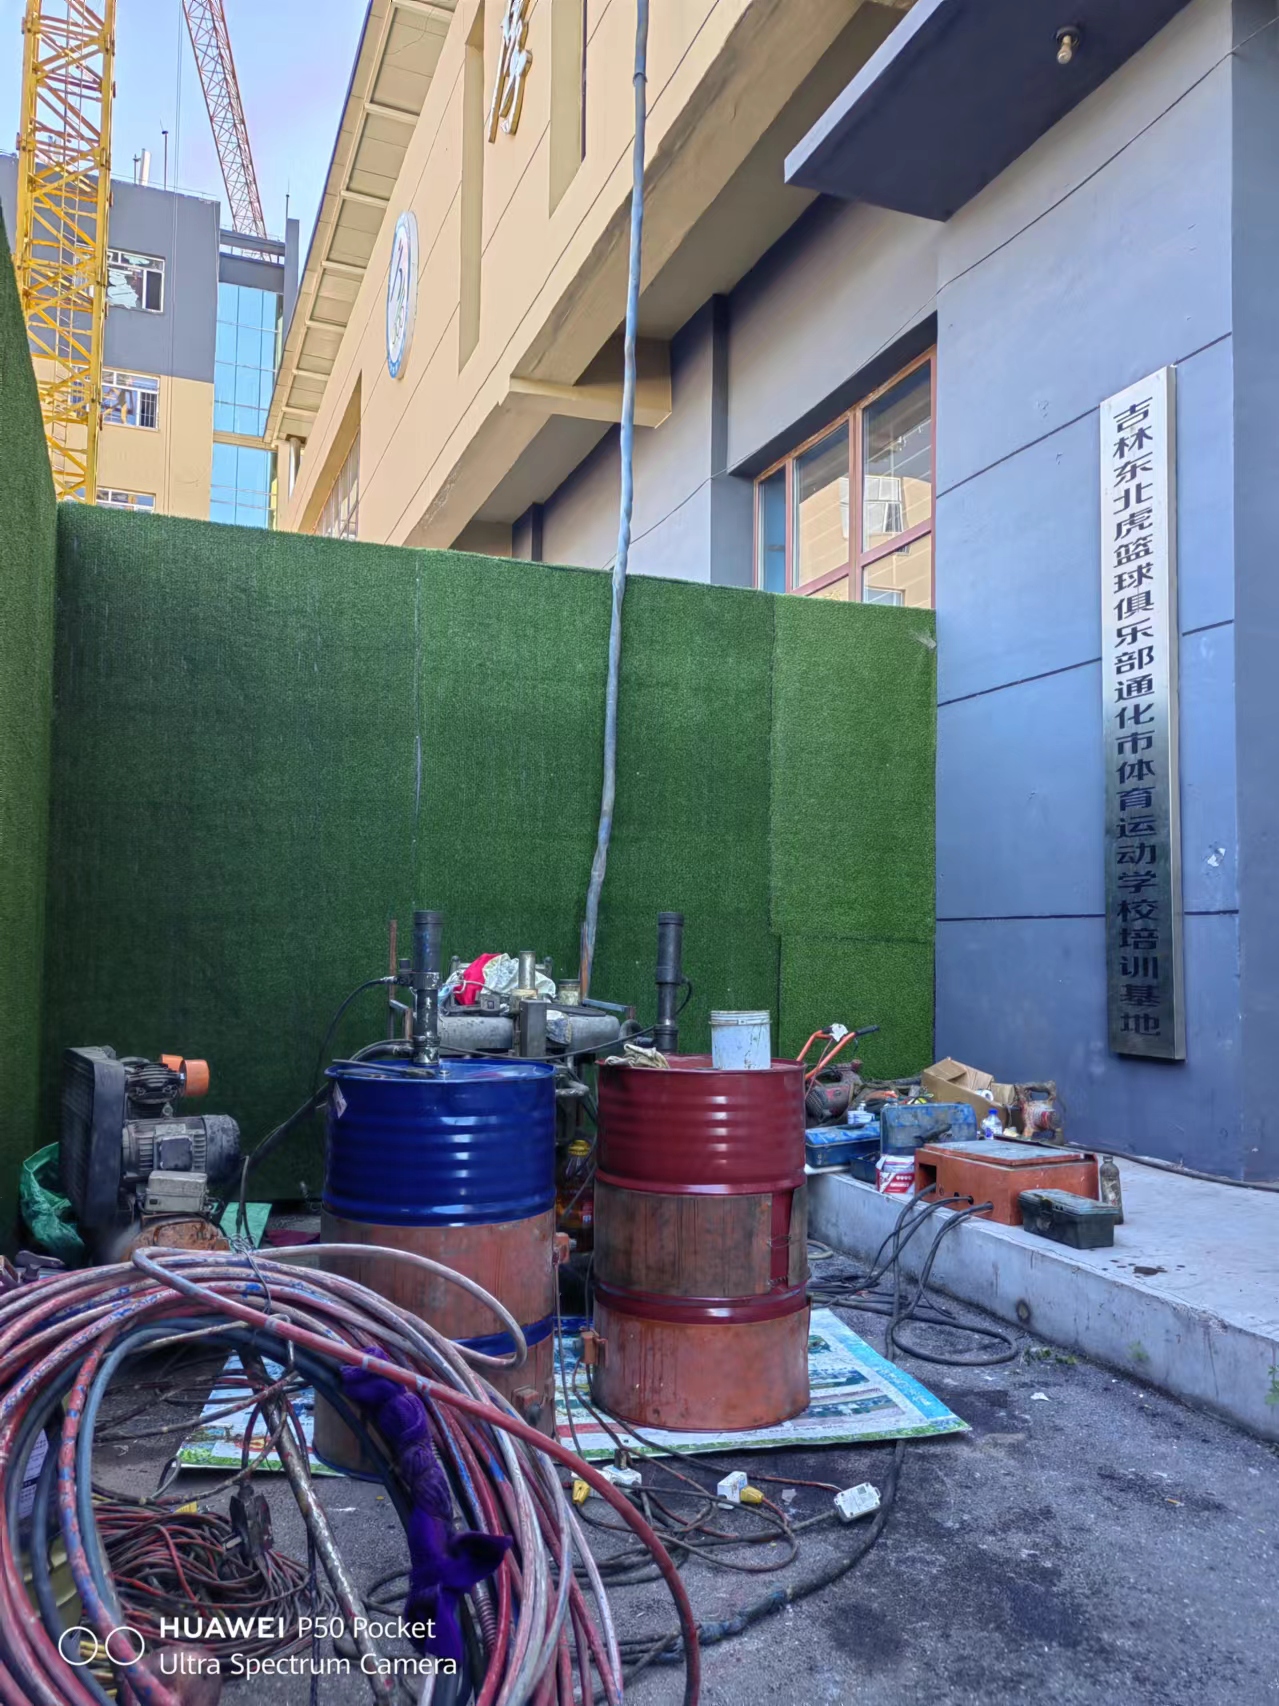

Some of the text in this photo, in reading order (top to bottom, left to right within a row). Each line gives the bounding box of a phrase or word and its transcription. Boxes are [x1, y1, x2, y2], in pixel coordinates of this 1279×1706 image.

[1113, 396, 1160, 1037] 吉林东北虎篮球俱乐部通化市体育运动学校培训基地
